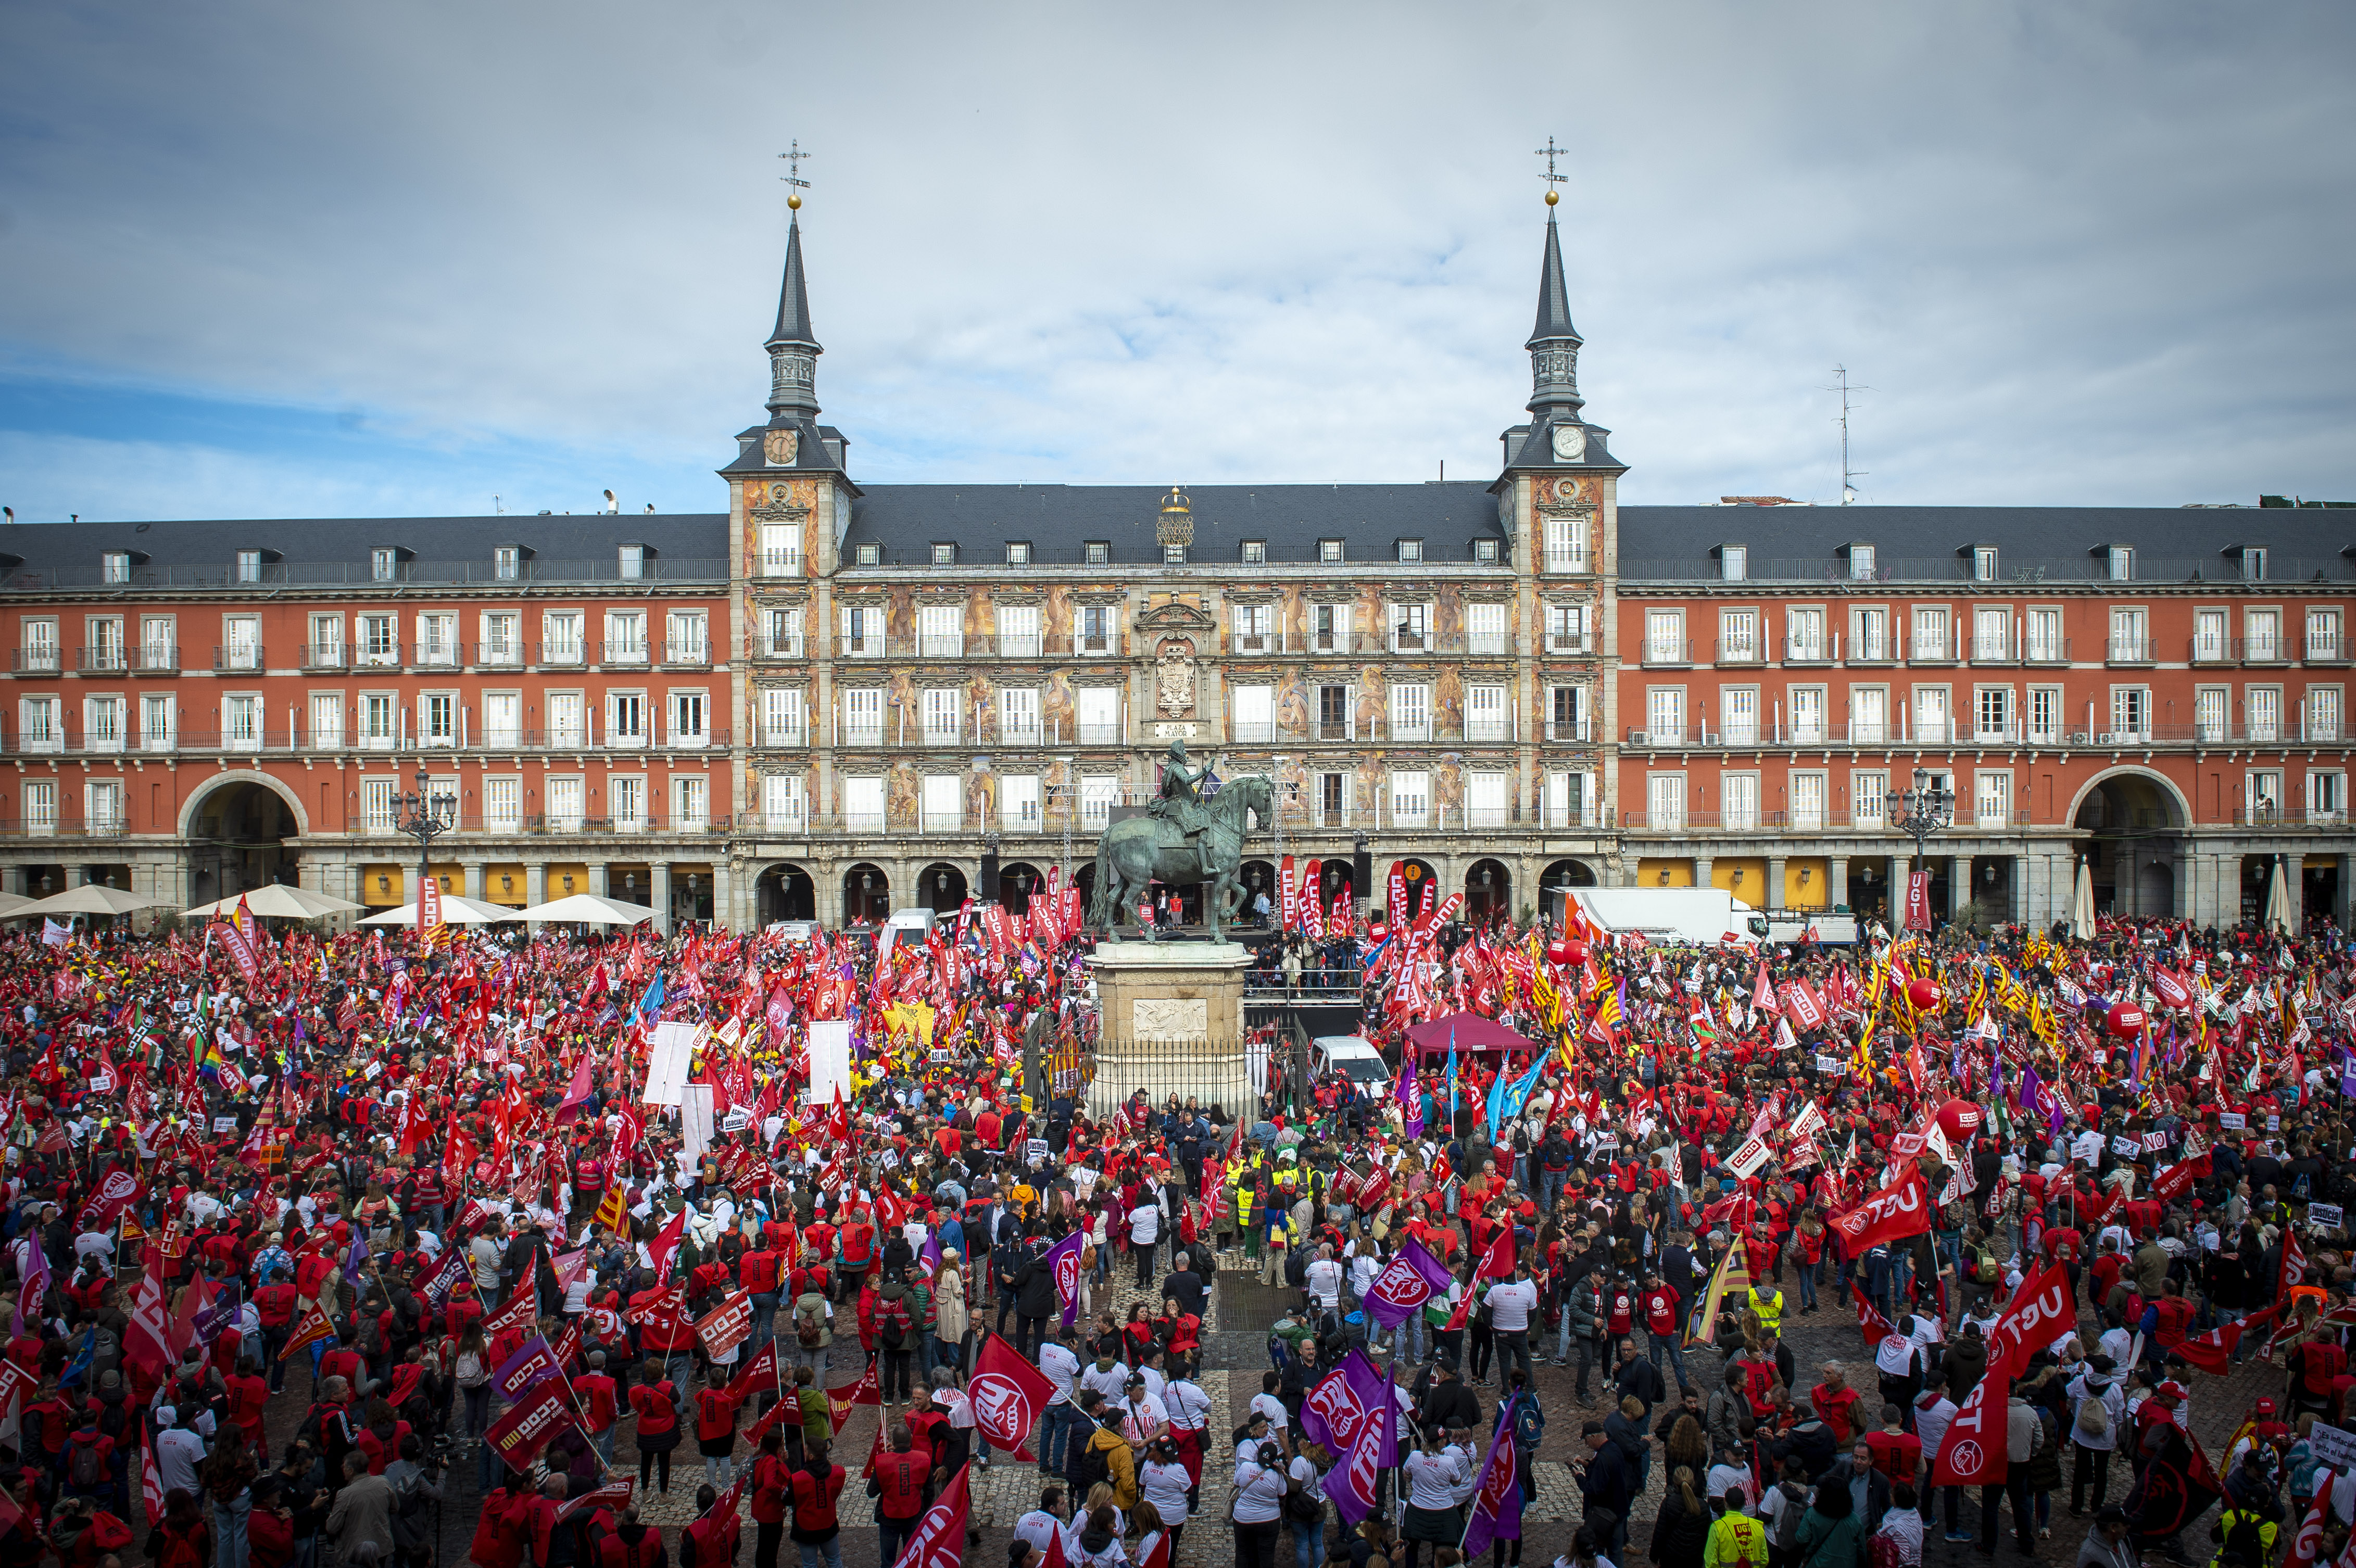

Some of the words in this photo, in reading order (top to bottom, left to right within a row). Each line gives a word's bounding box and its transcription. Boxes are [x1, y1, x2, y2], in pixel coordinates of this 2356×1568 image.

[424, 879, 436, 926] CCOO
[1421, 884, 1433, 914] CC
[1910, 874, 1921, 916] UGT
[242, 917, 253, 947] CC
[988, 912, 1003, 943] UGT
[1011, 916, 1020, 938] UG
[1039, 908, 1055, 939] UGT
[222, 928, 250, 968] CCOO
[945, 950, 955, 986] UGT
[1395, 930, 1423, 1001] CCOO
[78, 1025, 90, 1036] NO
[694, 1027, 709, 1044] CCOO
[723, 1021, 738, 1038] CCOO
[485, 1049, 498, 1061] NO
[941, 1052, 947, 1060] NO
[1471, 1085, 1483, 1110] GT
[1797, 1110, 1817, 1135] CCOO
[1028, 1141, 1047, 1151] ¡Justicia!
[2115, 1139, 2128, 1147] NO!
[2144, 1133, 2164, 1150] NO
[1734, 1142, 1759, 1167] CCOO
[1743, 1160, 1755, 1171] Castilla
[1757, 1150, 1765, 1160] León
[2310, 1206, 2341, 1221] ¡Justicia!
[161, 1220, 177, 1253] CCO
[1956, 1382, 1984, 1433] GT
[1124, 1417, 1155, 1440] GANAS
[2315, 1443, 2328, 1453] grita
[2330, 1447, 2336, 1456] el
[900, 1464, 909, 1496] CCOO
[816, 1479, 826, 1508] CCOO
